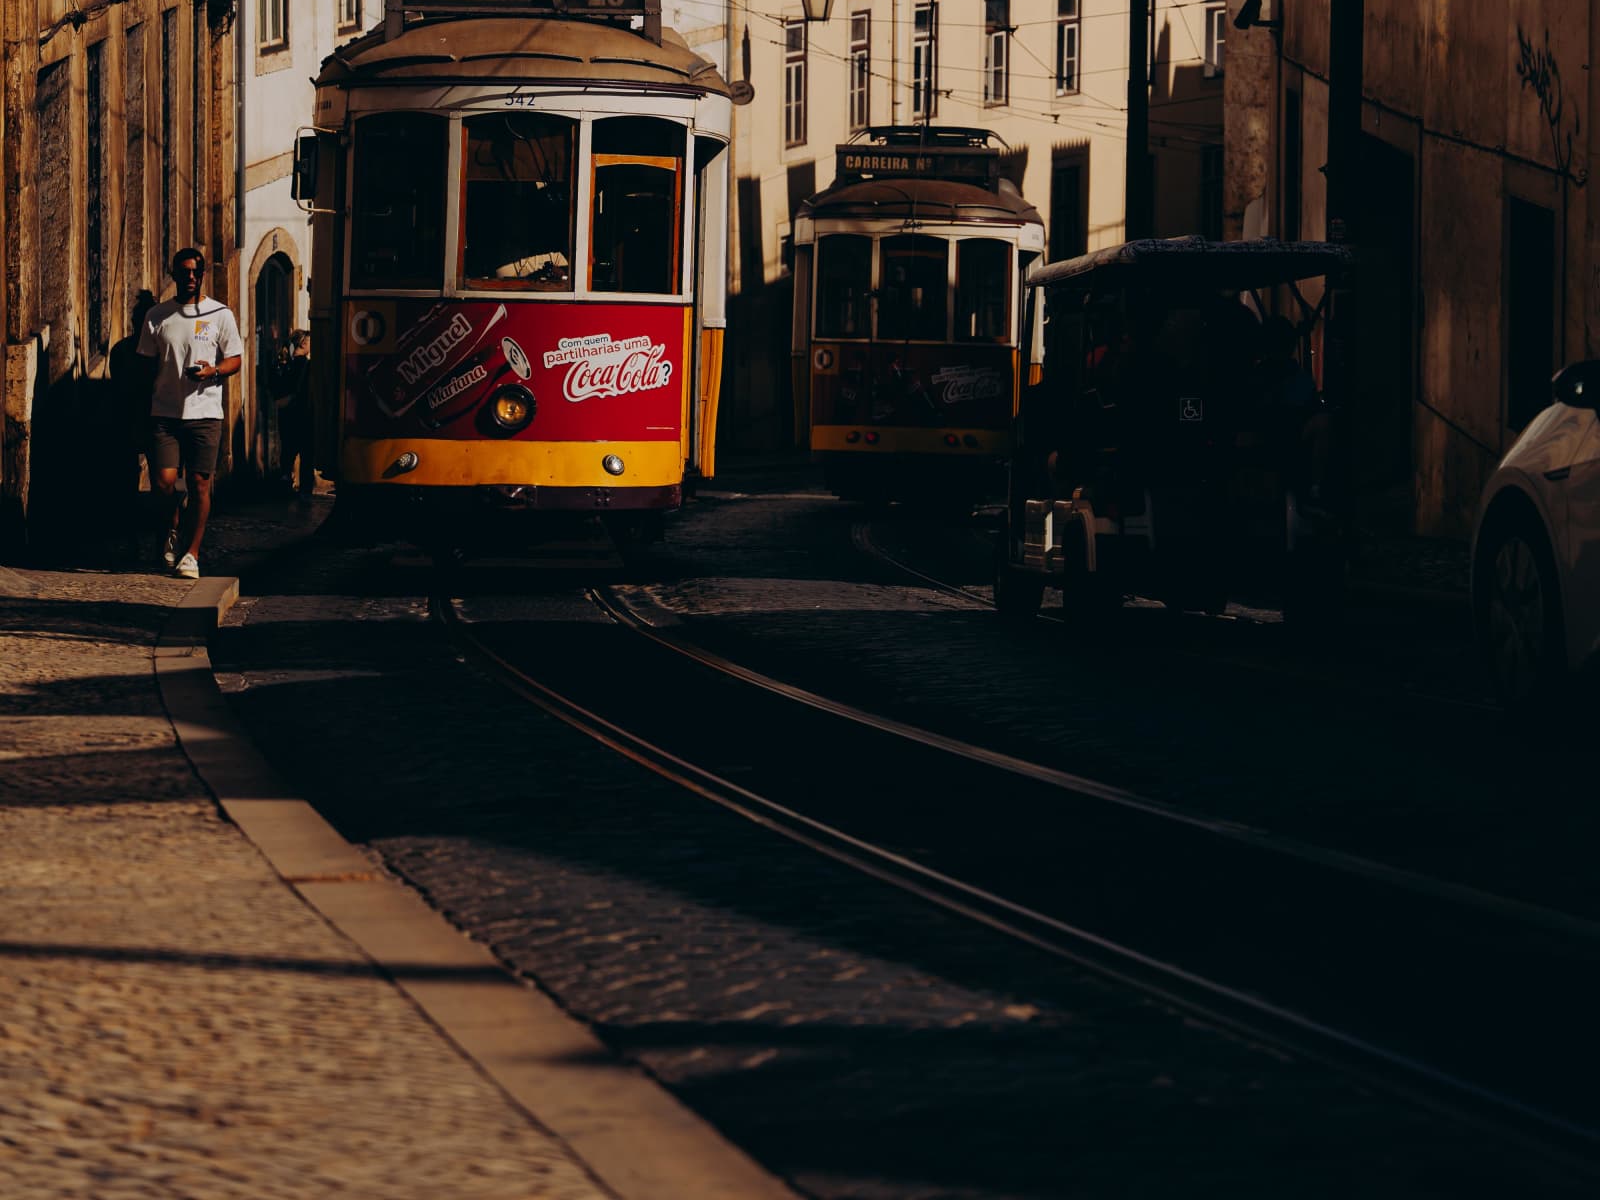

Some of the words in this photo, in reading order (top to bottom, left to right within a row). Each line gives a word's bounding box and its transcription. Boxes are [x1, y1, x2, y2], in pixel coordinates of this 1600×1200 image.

[505, 93, 536, 106] 542
[844, 155, 909, 171] CARREIRA
[396, 311, 473, 385] Miguel
[546, 343, 621, 365] partilharias
[624, 338, 649, 351] uma
[561, 340, 582, 349] Com
[584, 336, 609, 346] quem
[426, 364, 488, 408] Mariana
